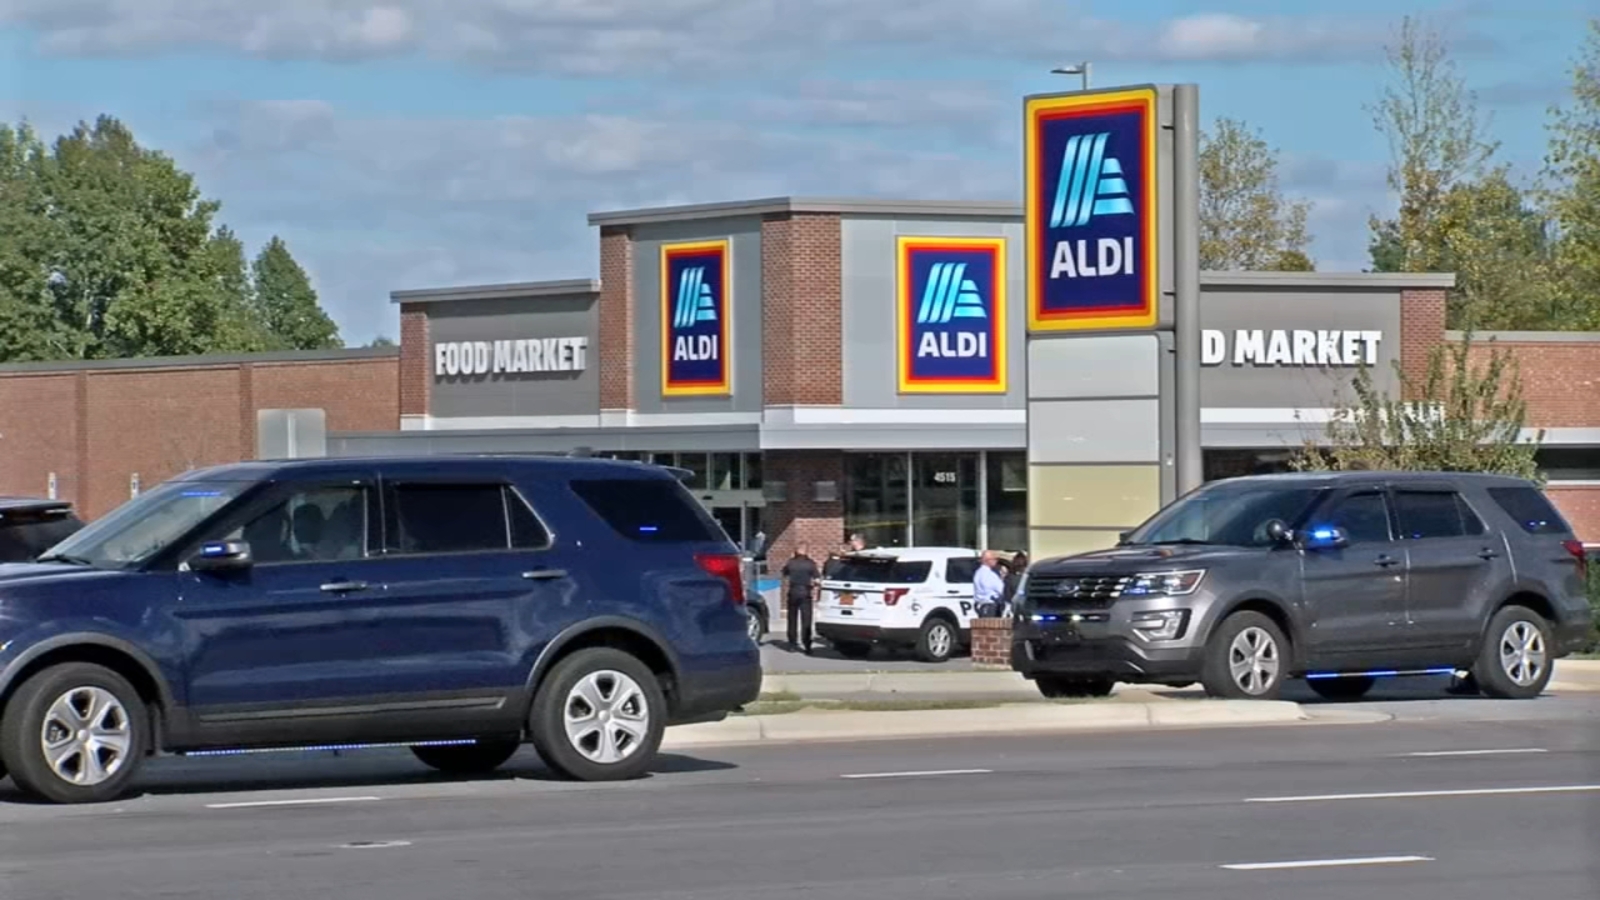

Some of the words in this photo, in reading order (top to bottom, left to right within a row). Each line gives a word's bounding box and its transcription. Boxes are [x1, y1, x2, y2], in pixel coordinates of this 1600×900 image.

[1050, 236, 1135, 279] ALDI
[435, 341, 491, 376] FOOD
[493, 336, 588, 373] MARKET
[674, 335, 718, 361] ALDI
[917, 331, 988, 358] ALDI
[1234, 330, 1382, 365] MARKET
